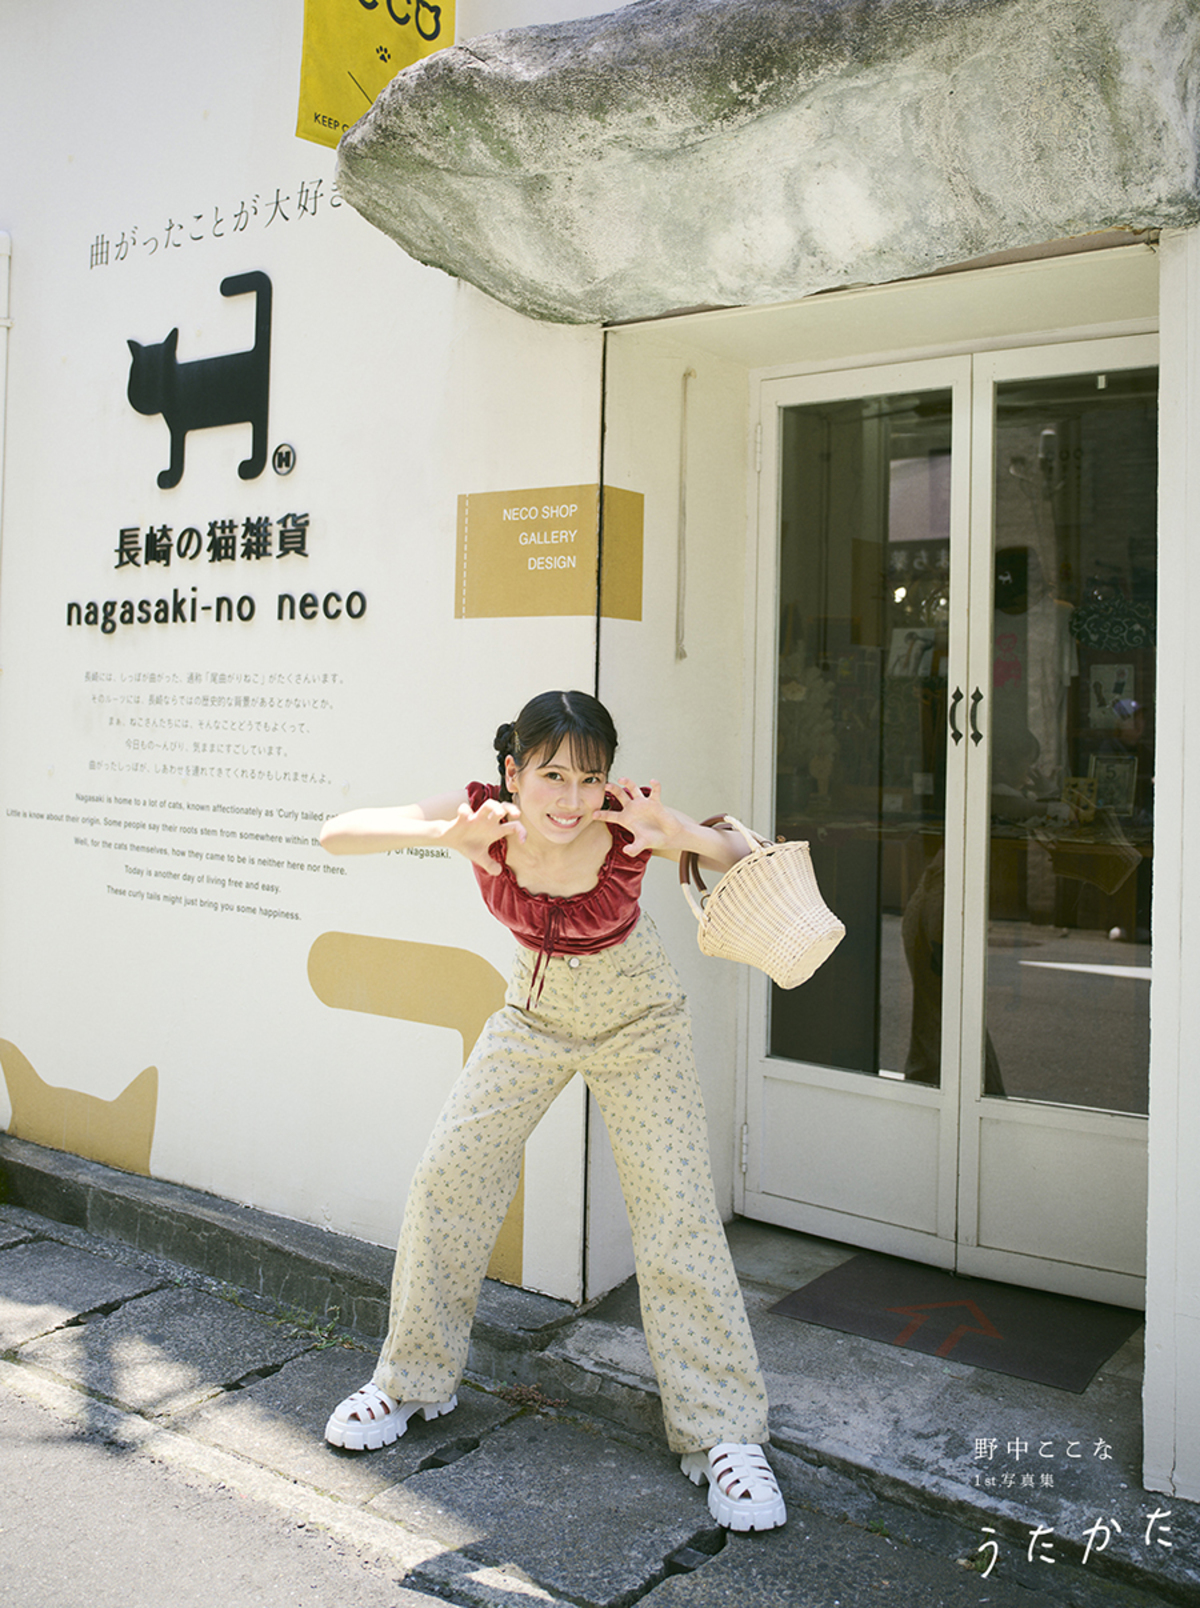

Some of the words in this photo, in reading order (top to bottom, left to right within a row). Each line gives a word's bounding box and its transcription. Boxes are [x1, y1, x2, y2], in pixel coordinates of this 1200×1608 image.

[313, 111, 340, 131] KEEP
[502, 506, 539, 521] NECO
[541, 504, 578, 519] SHOP
[114, 512, 309, 569] 長崎の猫雑貨
[518, 529, 578, 546] GALLERY
[527, 555, 577, 571] DESIGN
[66, 586, 256, 634] nagasaki-no
[276, 590, 367, 621] neco
[74, 792, 104, 803] Nagasaki
[106, 795, 112, 803] is
[113, 795, 132, 805] home
[133, 797, 141, 806] to
[147, 798, 157, 807] lot
[158, 799, 166, 808] of
[167, 801, 185, 809] cats,
[185, 801, 210, 811] known
[211, 803, 262, 818] affectionately
[264, 808, 274, 817] as
[300, 810, 324, 821] tailed
[5, 808, 21, 817] Little
[21, 810, 27, 818] is
[28, 811, 45, 819] know
[45, 812, 64, 821] about
[64, 814, 79, 822] their
[80, 816, 101, 826] origin.
[102, 816, 122, 827] Some
[122, 820, 146, 830] people
[147, 822, 160, 832] say
[161, 823, 177, 832] their
[178, 825, 198, 834] roots
[199, 827, 218, 836] stem
[219, 828, 237, 838] from
[238, 831, 283, 843] somewhere
[284, 834, 309, 845] within
[406, 847, 452, 860] Nagasaki.
[73, 836, 89, 846] Well,
[90, 838, 100, 847] for
[101, 840, 112, 849] the
[113, 842, 128, 850] cats
[128, 843, 169, 855] themselves,
[170, 847, 186, 856] how
[187, 849, 203, 861] they
[204, 852, 225, 861] came
[226, 853, 235, 863] to
[236, 854, 247, 864] be
[247, 855, 255, 865] is
[256, 857, 285, 868] neither
[285, 859, 305, 871] here
[306, 863, 321, 872] nor
[322, 863, 348, 875] there.
[124, 864, 144, 877] Today
[145, 868, 152, 876] is
[153, 870, 180, 880] another
[181, 872, 195, 884] day
[196, 874, 204, 883] of
[205, 874, 226, 888] living
[227, 877, 243, 888] free
[244, 880, 259, 890] and
[260, 883, 281, 895] easy.
[106, 884, 126, 896] These
[127, 889, 144, 900] curly
[145, 891, 161, 901] tails
[162, 894, 182, 905] might
[183, 896, 198, 907] just
[198, 898, 219, 911] bring
[220, 902, 234, 913] you
[235, 904, 257, 914] some
[258, 906, 302, 920] happiness.
